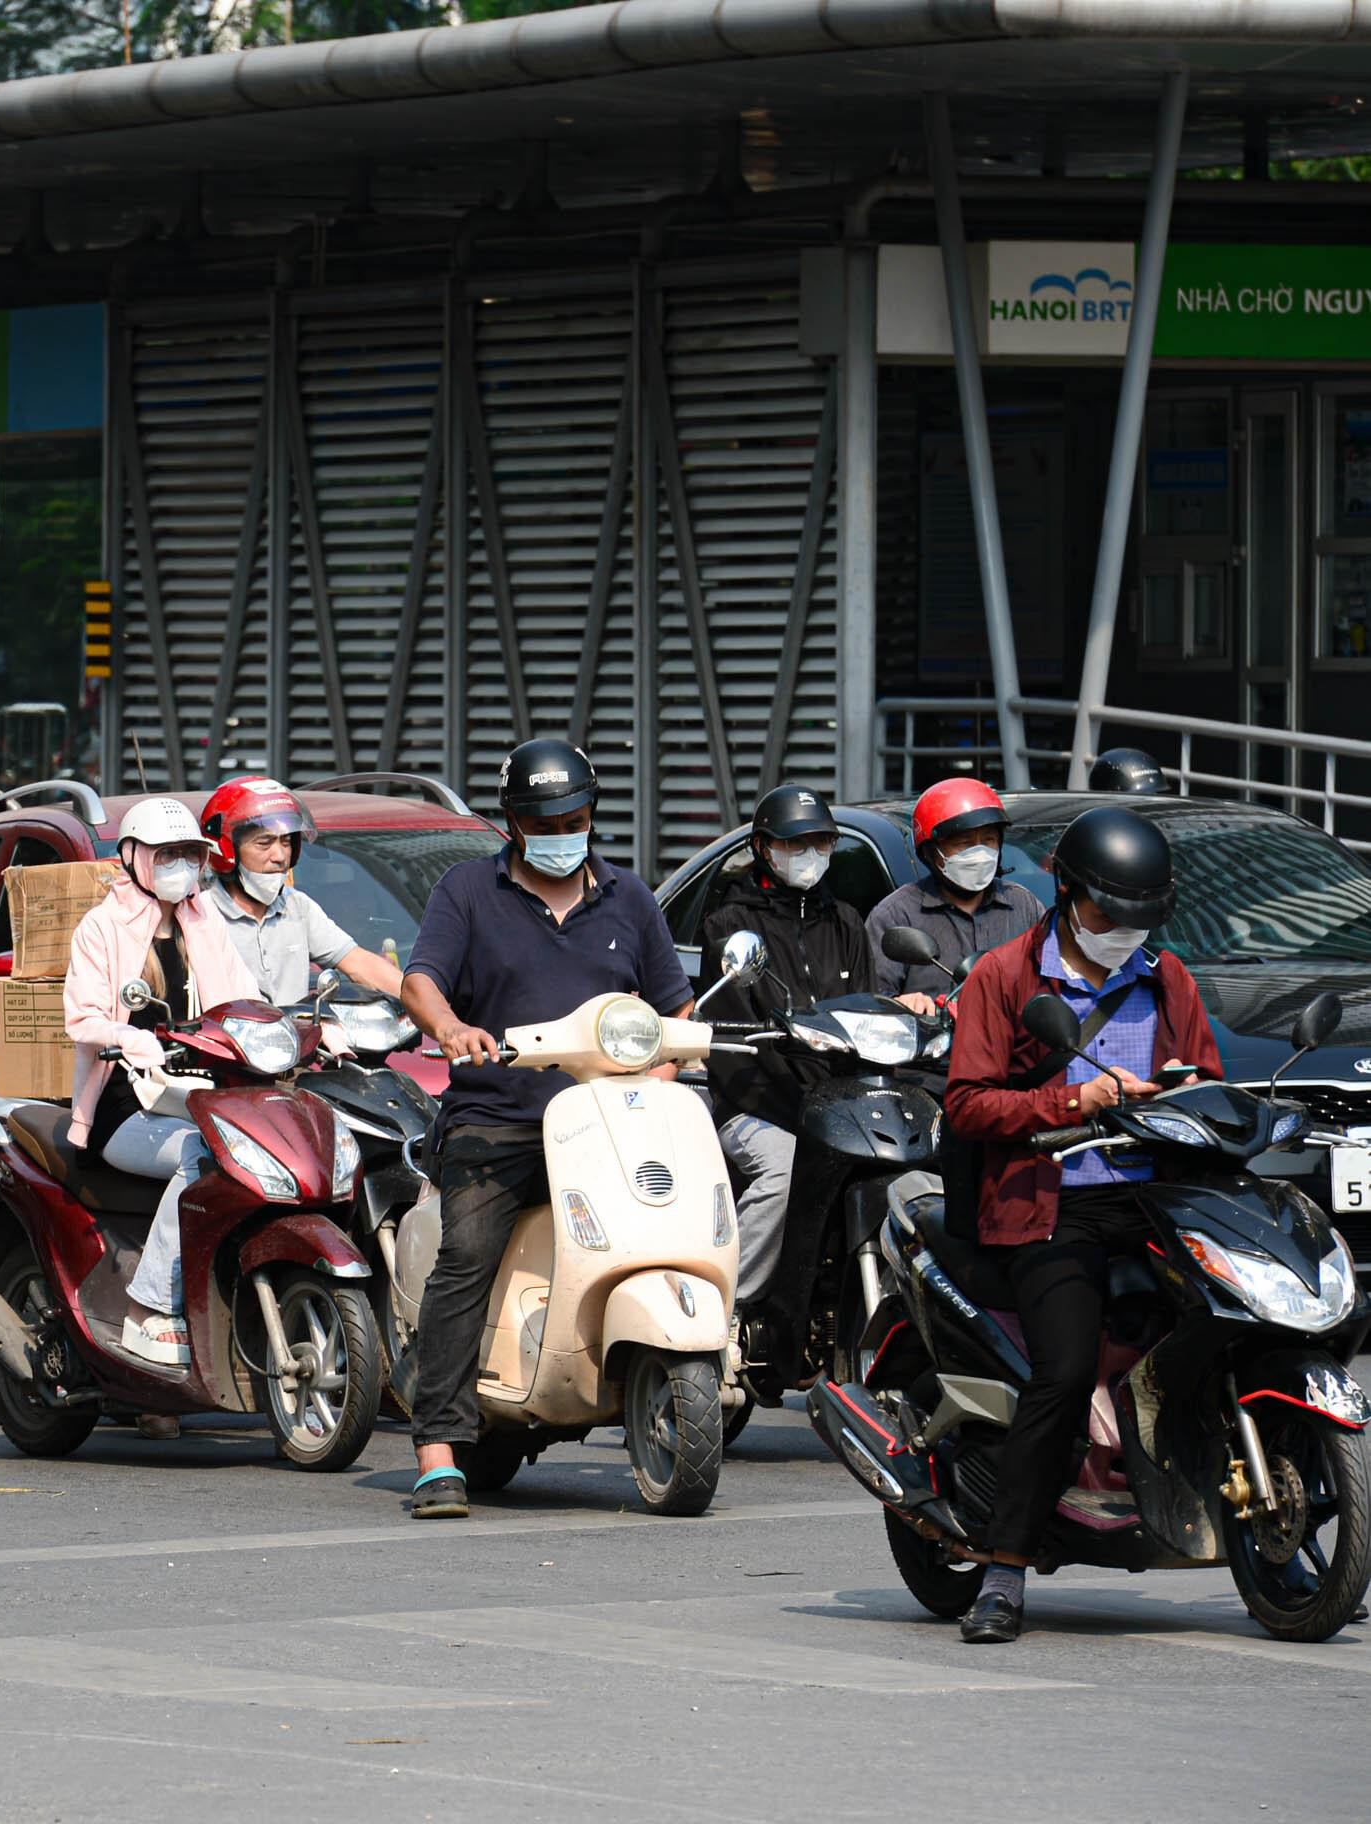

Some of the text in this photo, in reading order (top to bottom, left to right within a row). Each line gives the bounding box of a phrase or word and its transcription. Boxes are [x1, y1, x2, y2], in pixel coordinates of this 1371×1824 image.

[1177, 283, 1230, 313] NHÀ
[1238, 283, 1292, 314] CHỜ
[990, 300, 1132, 322] HANOI BRT
[866, 1089, 903, 1098] HONDA
